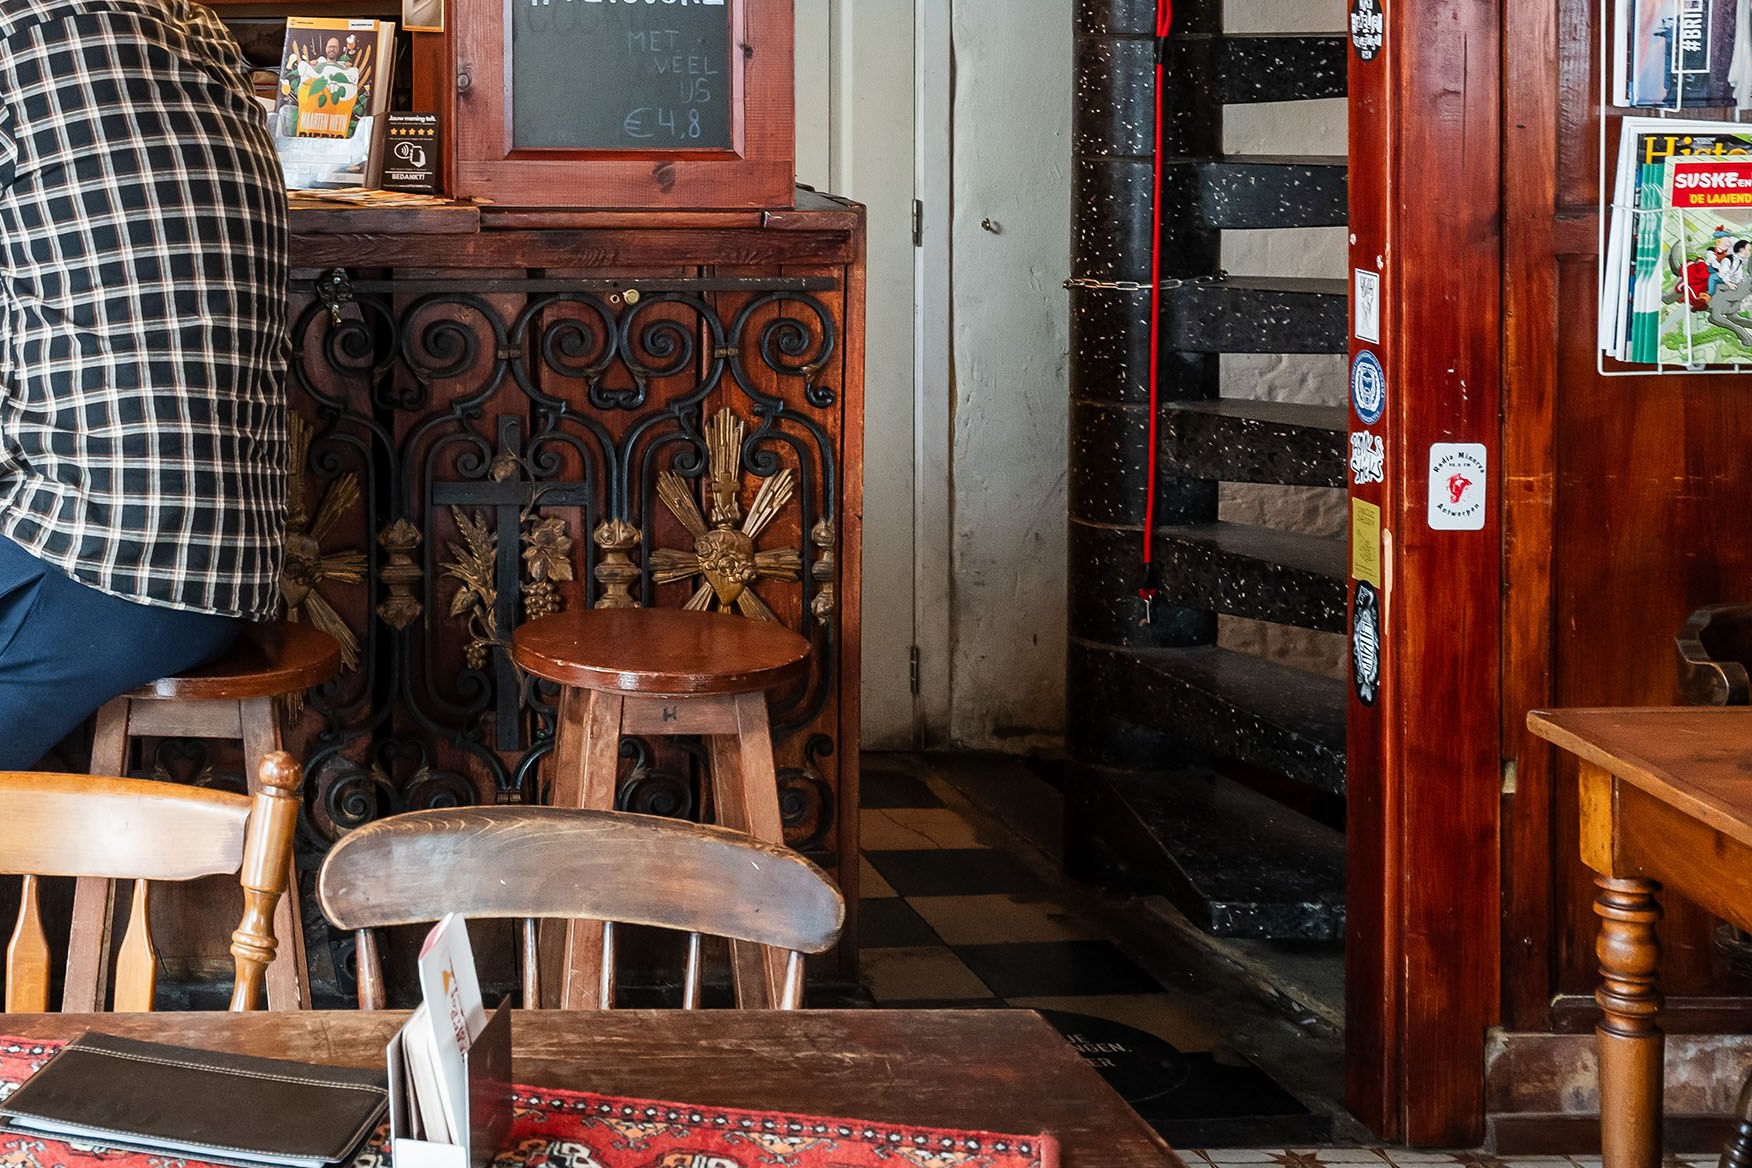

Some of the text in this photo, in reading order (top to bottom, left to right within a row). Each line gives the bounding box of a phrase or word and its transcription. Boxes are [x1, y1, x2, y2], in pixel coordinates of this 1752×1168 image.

[628, 30, 679, 53] MET
[1674, 172, 1739, 189] SUSKE
[1690, 193, 1752, 204] DE LAAIEND
[1433, 451, 1485, 473] Radio Minerva
[1437, 503, 1480, 517] Antwerpen
